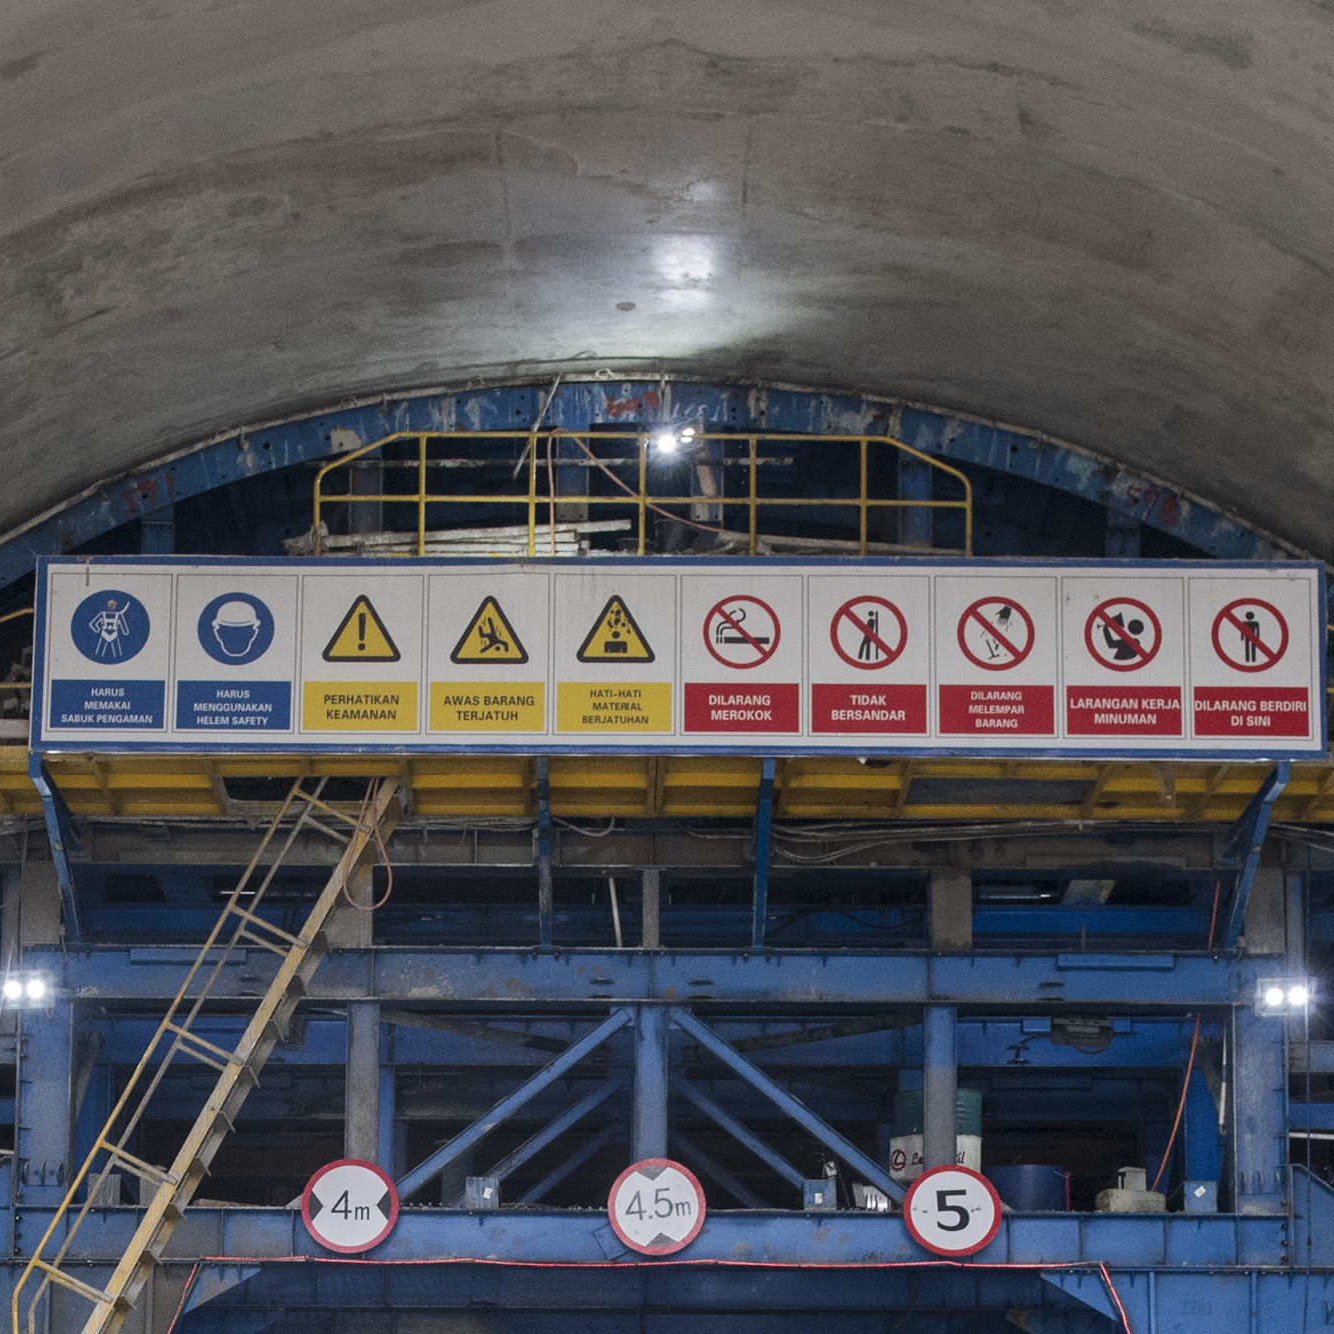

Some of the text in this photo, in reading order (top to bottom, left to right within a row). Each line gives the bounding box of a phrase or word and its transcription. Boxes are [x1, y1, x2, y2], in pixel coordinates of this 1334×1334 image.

[91, 688, 125, 697] HARUS
[216, 690, 250, 699] HARUS
[590, 689, 642, 699] HATI-HATI
[970, 691, 1023, 701] DILARANG
[84, 701, 131, 710] MEMAKAI
[323, 694, 400, 706] PERHATIKAN
[443, 695, 535, 707] AWAS BARANG
[708, 694, 771, 706] DILARANG
[850, 694, 887, 706] TIDAK
[1070, 698, 1180, 710] LARANGAN KERJA
[1194, 700, 1307, 712] DILARANG BERDIRI
[193, 703, 272, 712] MENGGUNAKAN
[592, 702, 642, 711] MATERIAL
[968, 705, 1025, 715] MELEMPAR
[61, 714, 153, 724] SABUK PENGAMAN
[326, 709, 396, 720] KEAMANAN
[456, 710, 519, 722] TERJATUH
[582, 715, 649, 725] BERJATUHAN
[710, 709, 772, 721] MEROKOK
[831, 709, 906, 721] BERSANDAR
[1094, 713, 1157, 725] MINUMAN
[196, 716, 268, 726] HELEM SAFETY
[975, 718, 1018, 729] BARANG
[1231, 715, 1271, 727] DI SINI
[330, 1189, 370, 1220] 4m
[625, 1187, 692, 1221] 4.5m
[936, 1189, 970, 1232] 5
